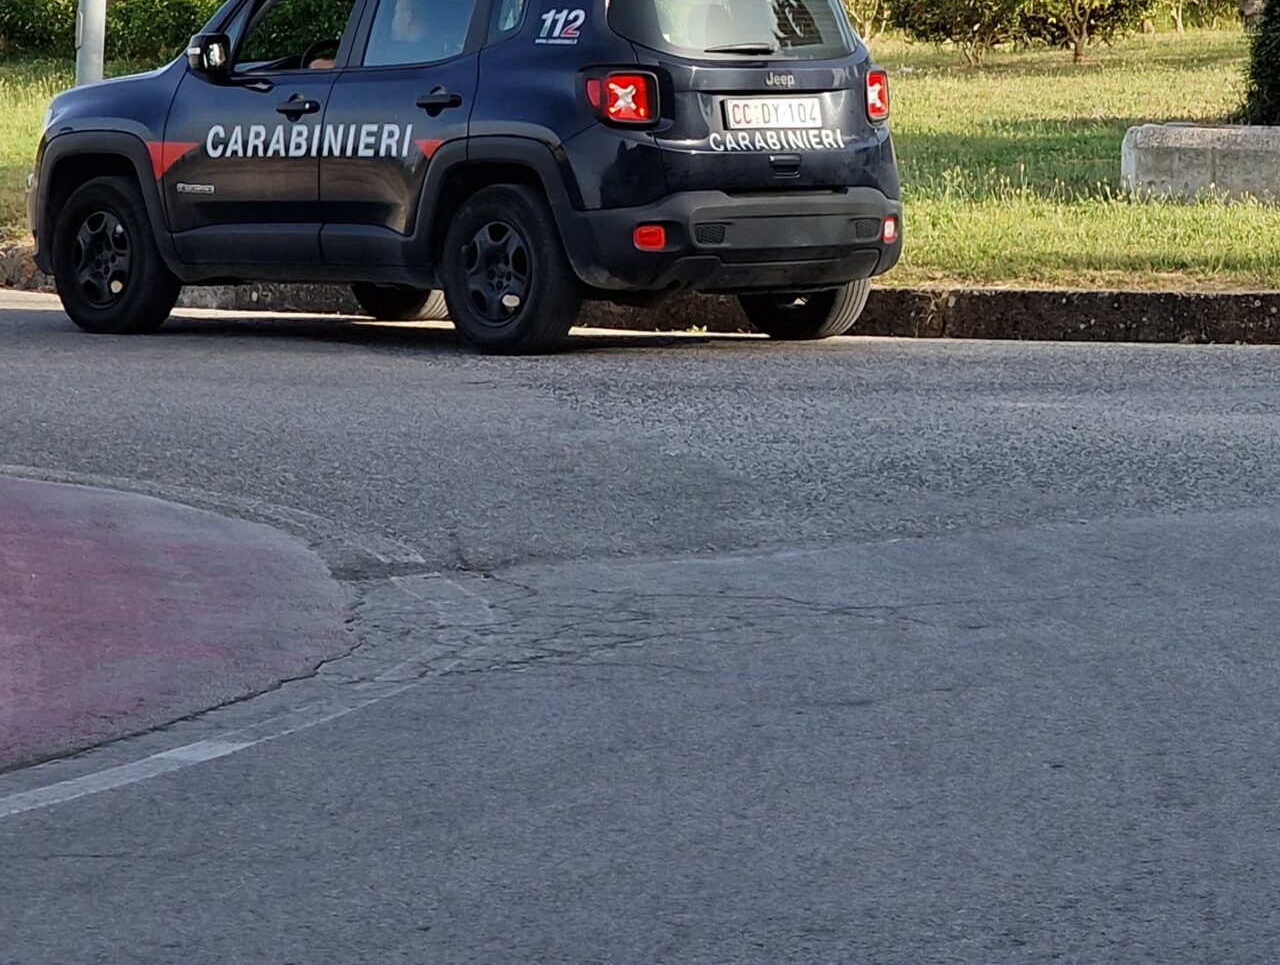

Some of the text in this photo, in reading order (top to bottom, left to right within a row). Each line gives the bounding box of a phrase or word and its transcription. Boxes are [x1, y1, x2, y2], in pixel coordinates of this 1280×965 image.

[540, 8, 586, 38] 112
[766, 71, 795, 88] Jeep
[206, 123, 413, 158] CARABINIERI
[709, 128, 846, 152] CARABINIERI
